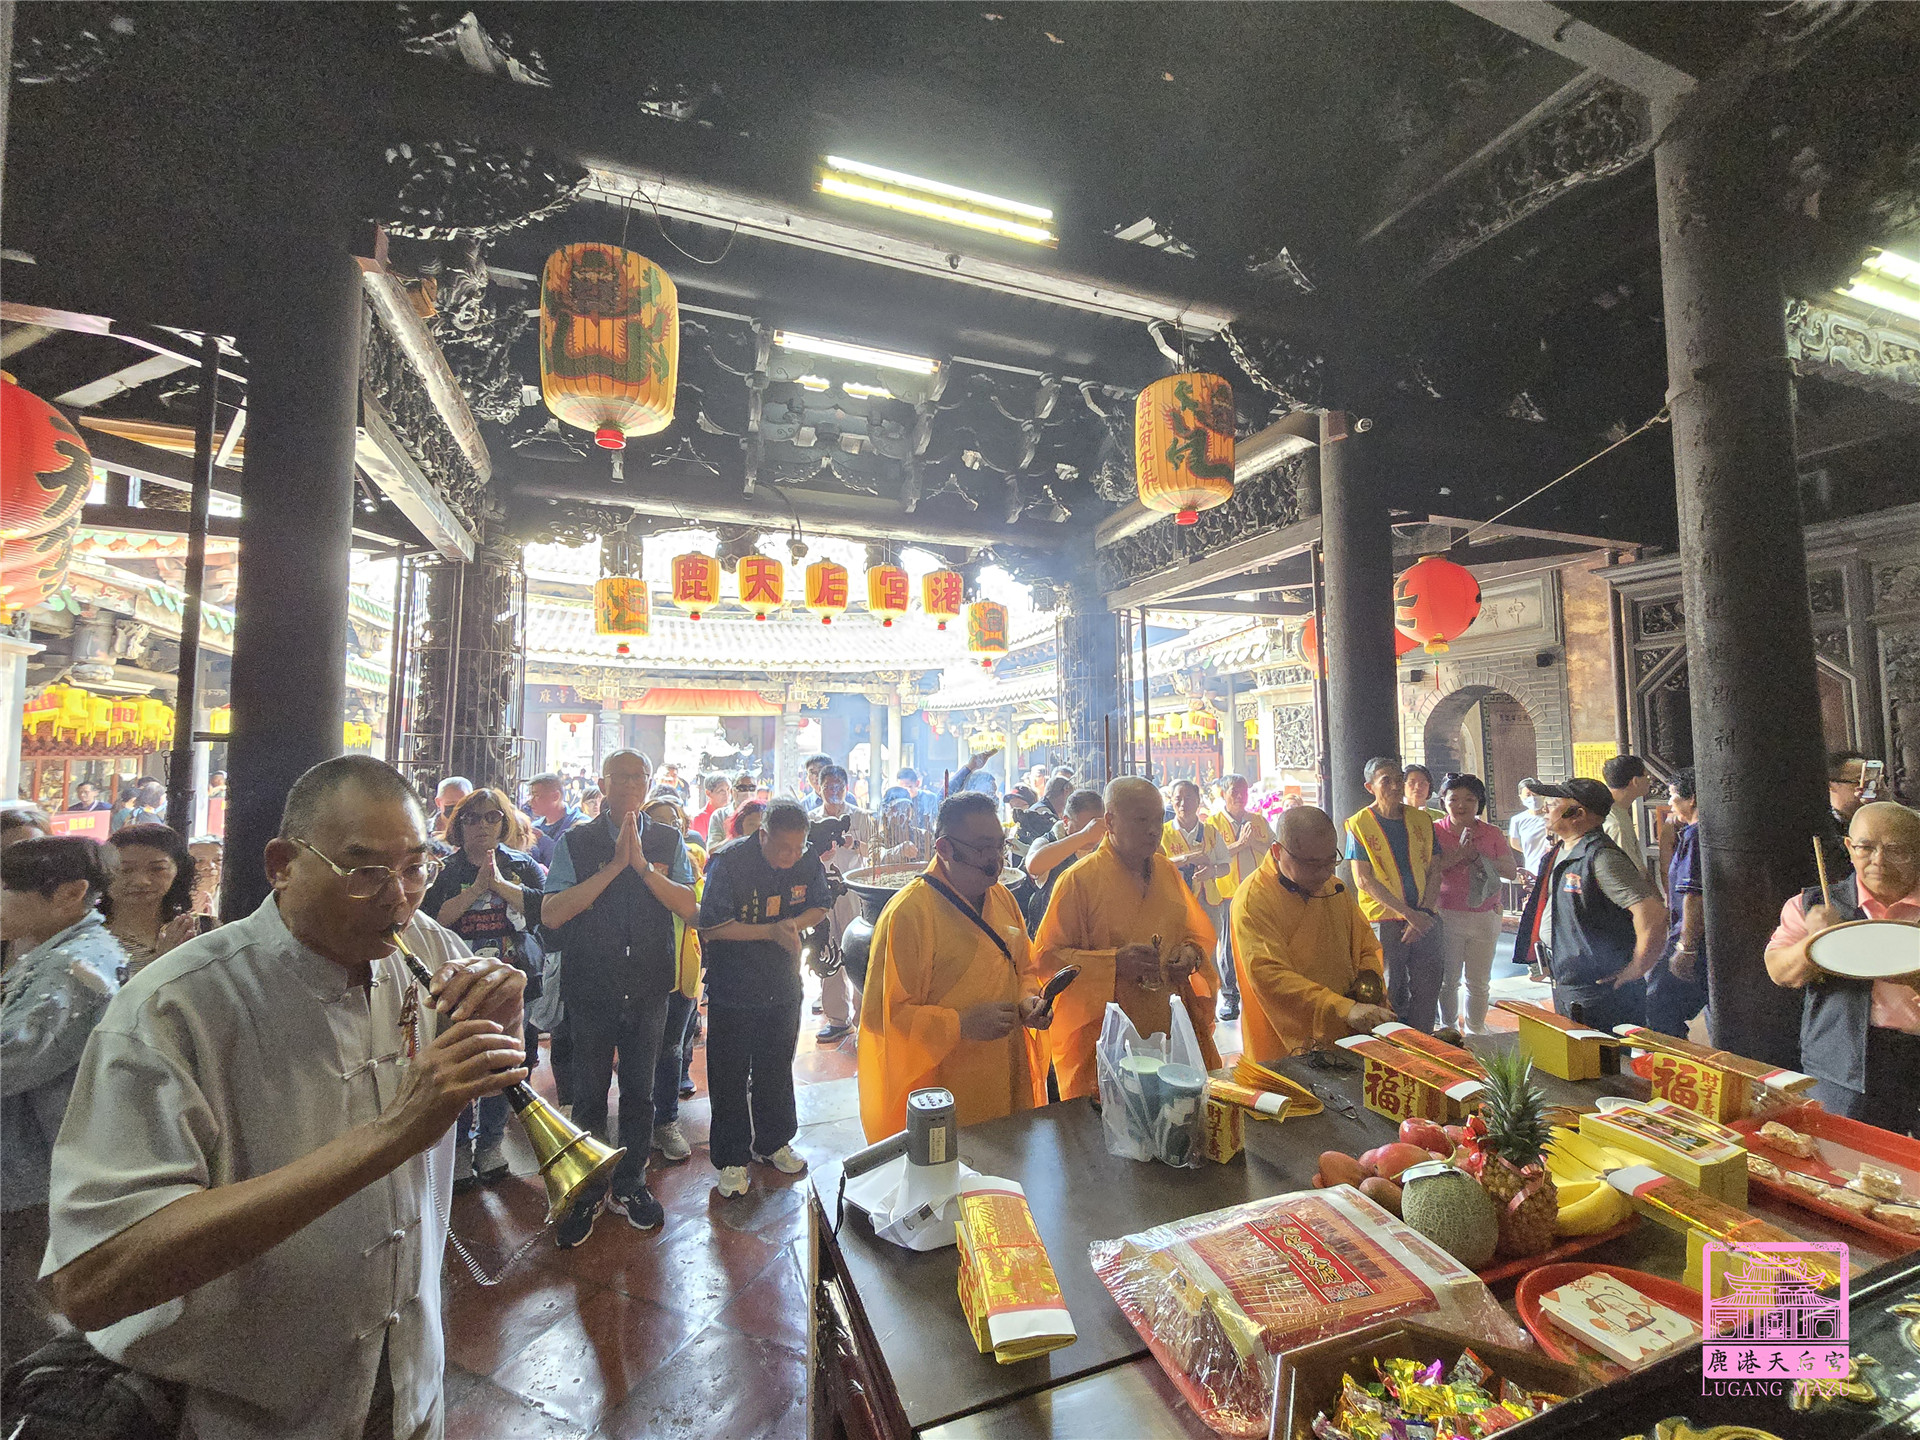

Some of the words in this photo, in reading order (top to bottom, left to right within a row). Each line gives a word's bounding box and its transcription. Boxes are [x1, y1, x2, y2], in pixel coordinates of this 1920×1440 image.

[673, 555, 712, 603] 鹿
[743, 558, 782, 604] 天
[813, 566, 849, 608] 后
[880, 569, 909, 612] 宮
[931, 571, 963, 614] 港
[1364, 1060, 1401, 1115] 福
[1653, 1057, 1700, 1111] 福
